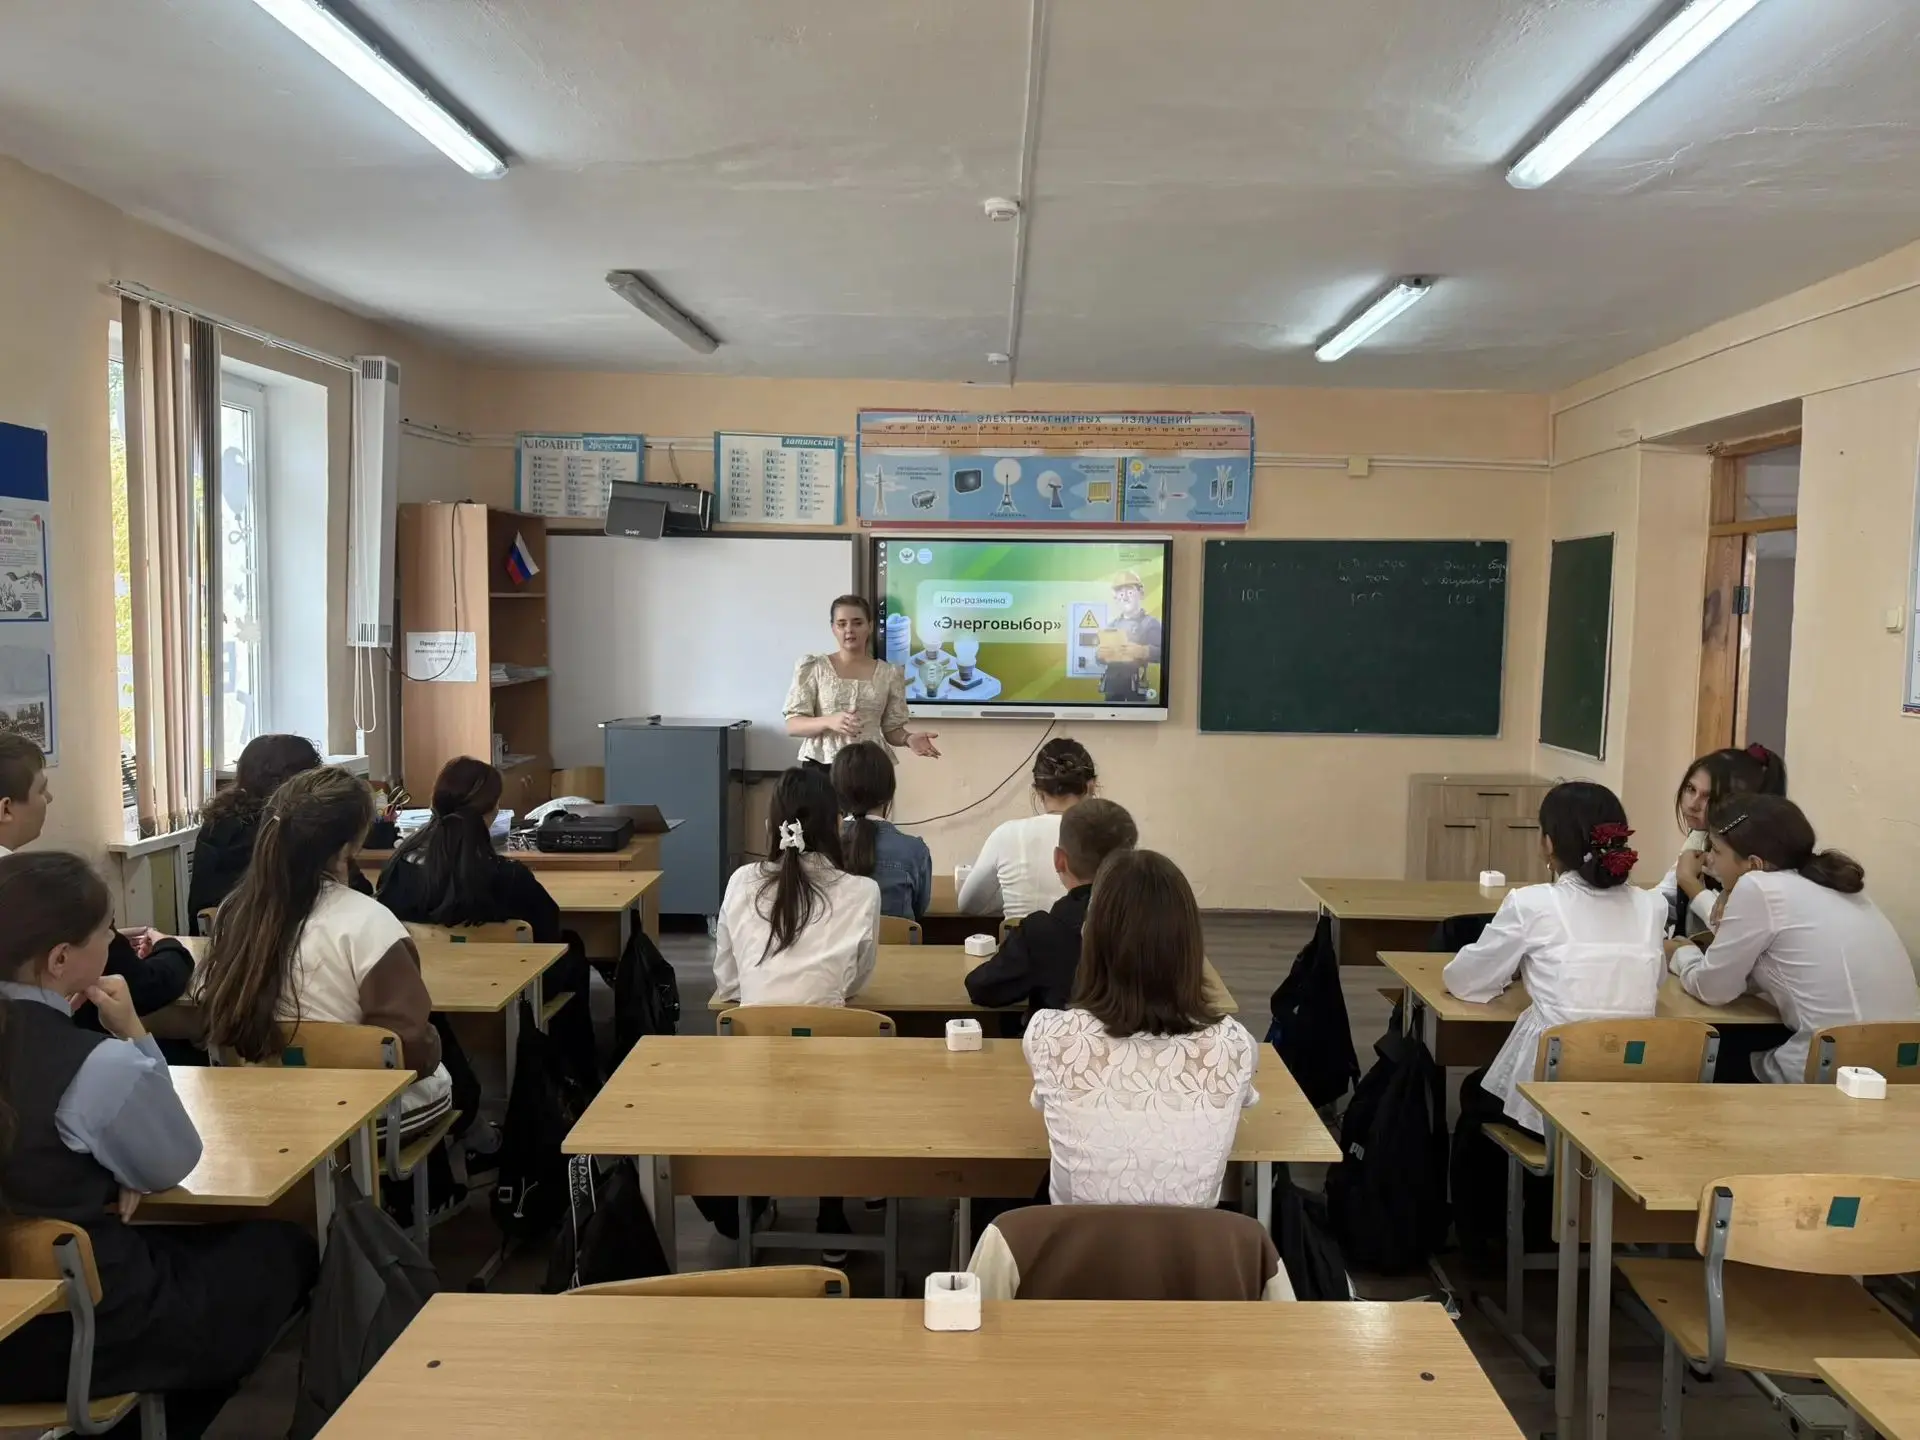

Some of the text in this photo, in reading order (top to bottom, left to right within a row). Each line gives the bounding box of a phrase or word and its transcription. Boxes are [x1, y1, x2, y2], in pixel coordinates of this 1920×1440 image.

[917, 414, 1191, 424] ШКАЛА ЭЛЕКТРОМАГНИТНЫХ ИЗЛУЧЕНИЙ
[523, 439, 581, 450] АЛФАВИТ
[940, 595, 1006, 606] Игра-разминка
[933, 616, 1062, 634] «Энерговыбор»
